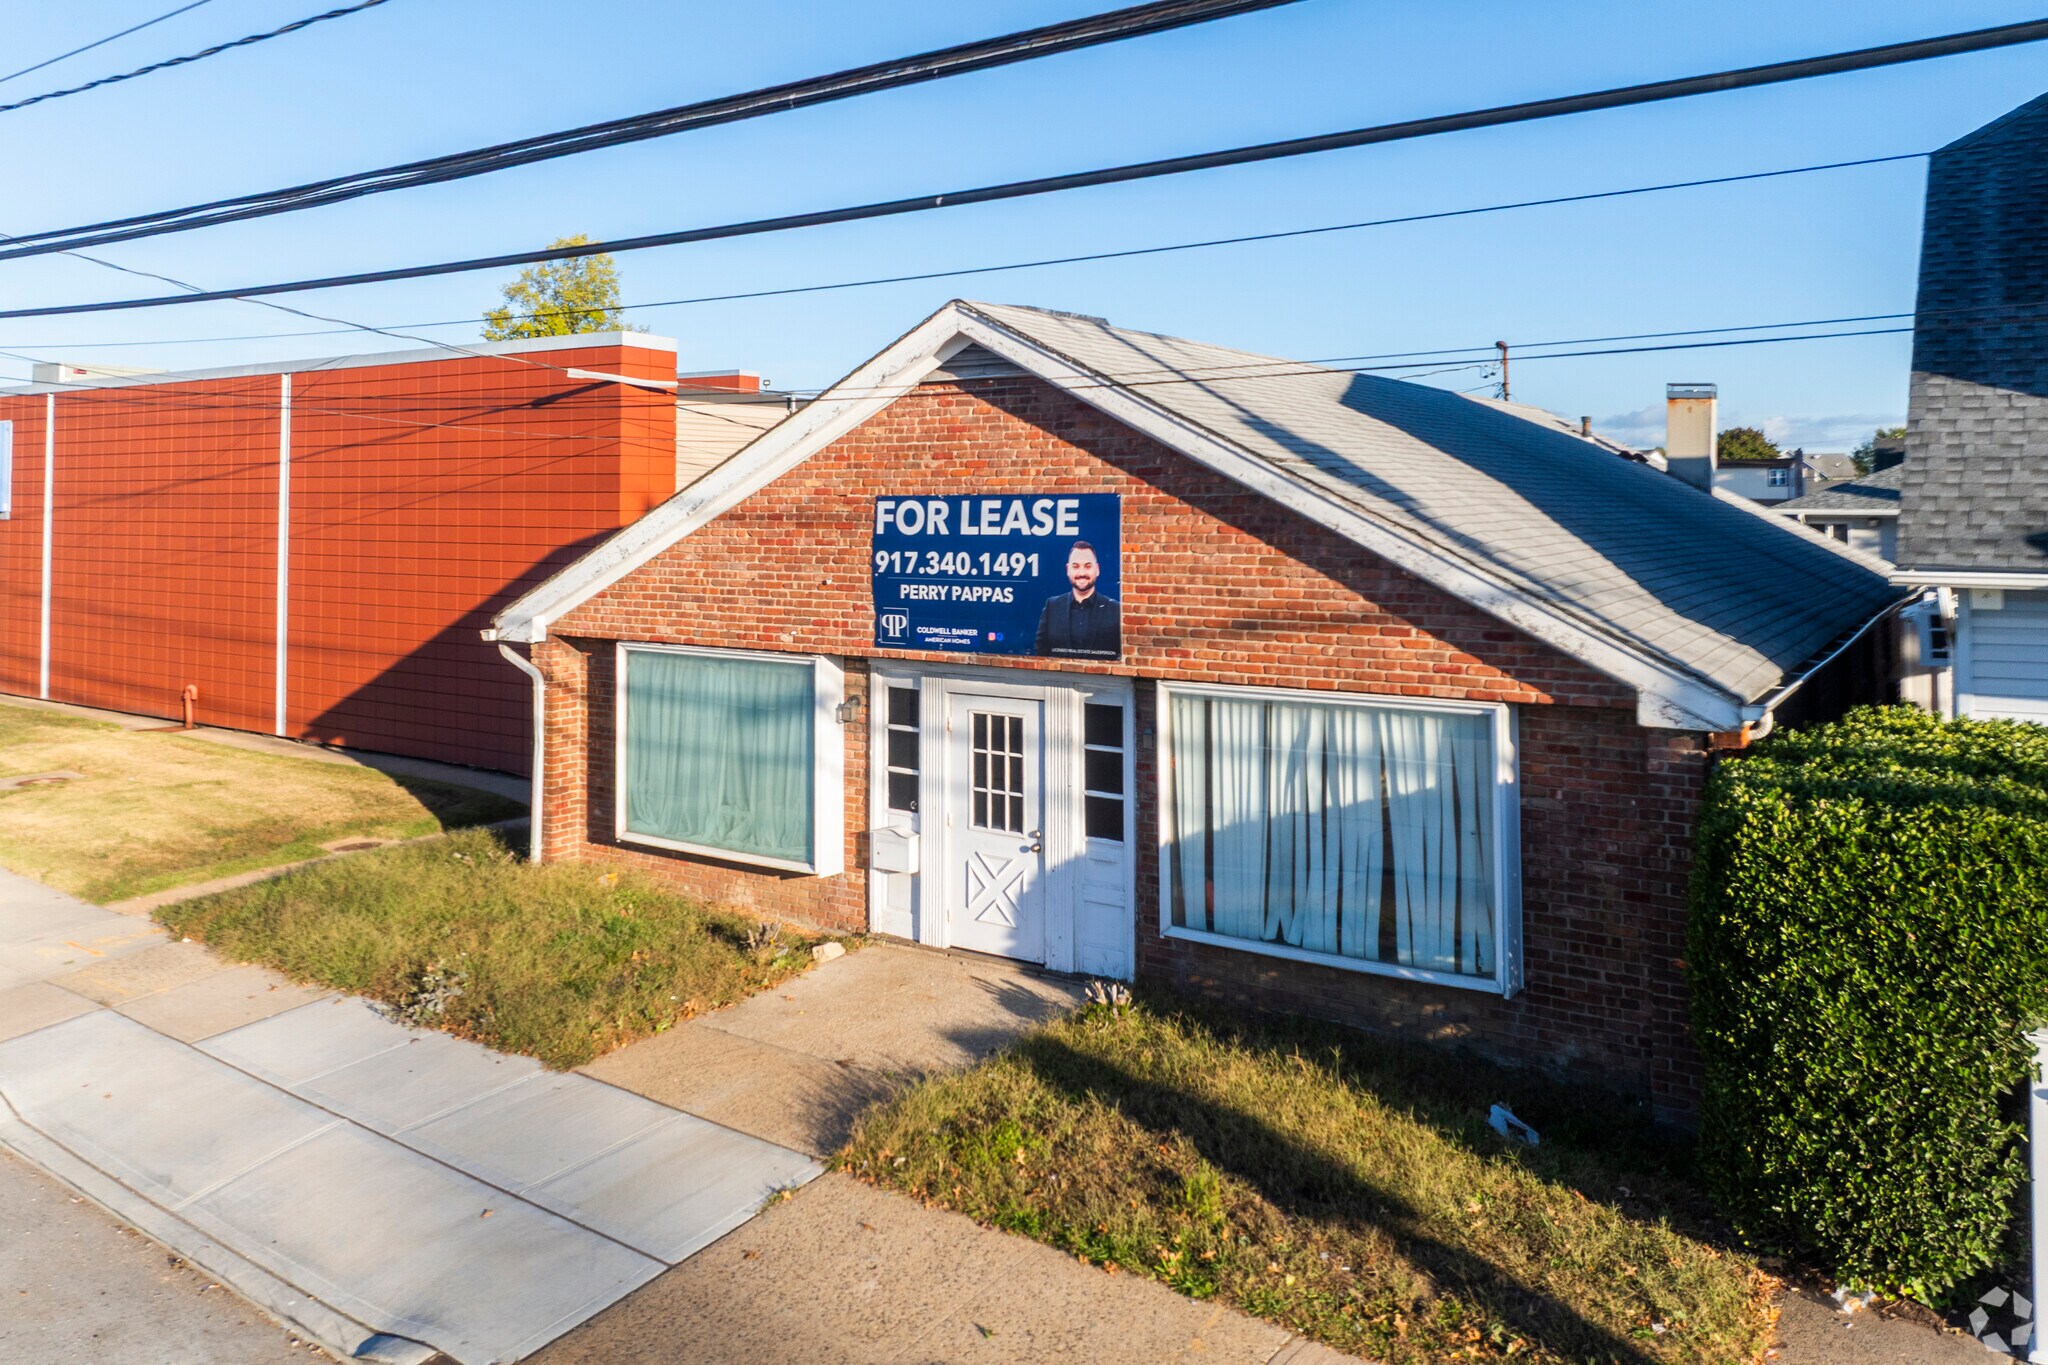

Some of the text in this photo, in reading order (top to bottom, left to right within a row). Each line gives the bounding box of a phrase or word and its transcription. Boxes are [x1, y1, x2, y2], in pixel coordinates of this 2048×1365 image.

[876, 499, 1080, 536] FOR LEASE
[875, 550, 1039, 577] 917.340.1491
[900, 584, 1014, 603] PERRY PAPPAS
[917, 626, 978, 636] COLDWELL BANKER
